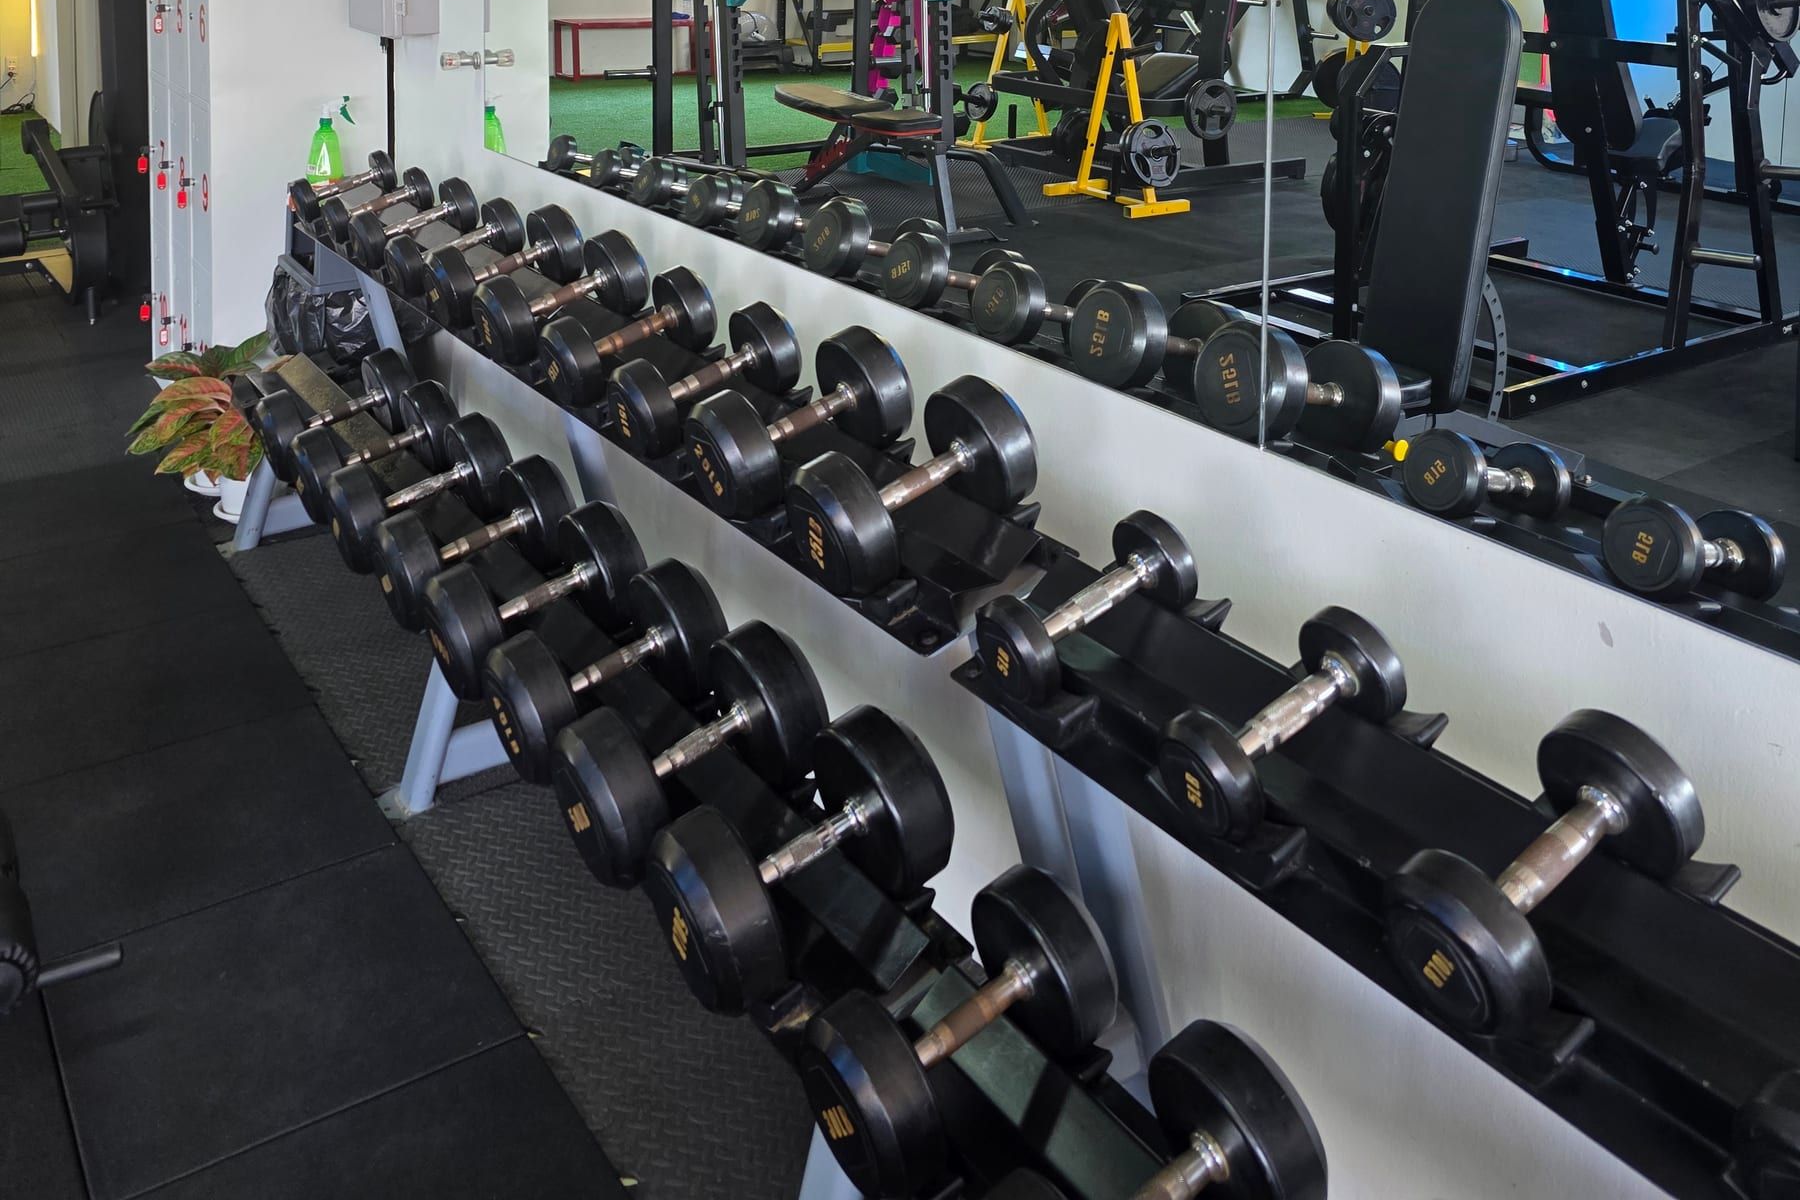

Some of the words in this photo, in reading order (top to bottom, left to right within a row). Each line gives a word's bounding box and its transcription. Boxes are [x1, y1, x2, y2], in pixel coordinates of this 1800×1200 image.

[199, 3, 206, 43] 6
[202, 172, 209, 212] 9
[808, 516, 825, 570] 25LB
[996, 647, 1010, 677] 5LB
[1184, 771, 1203, 809] 5LB
